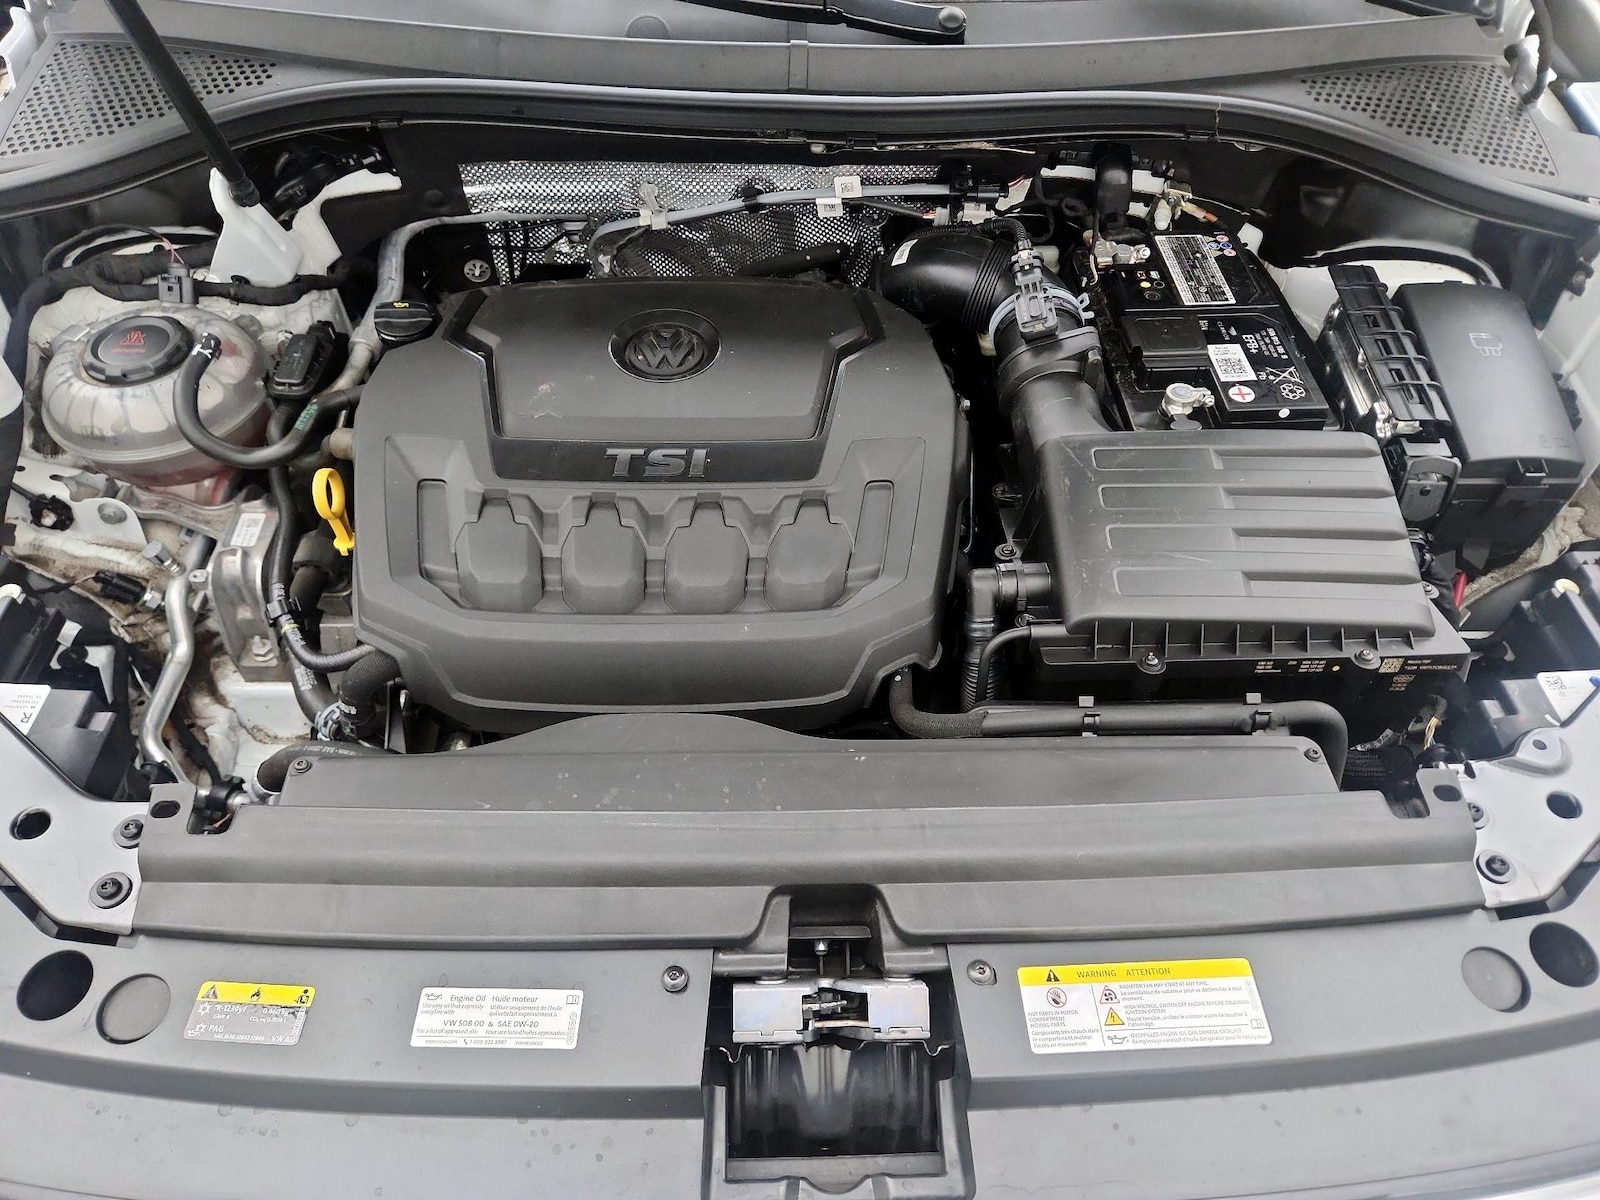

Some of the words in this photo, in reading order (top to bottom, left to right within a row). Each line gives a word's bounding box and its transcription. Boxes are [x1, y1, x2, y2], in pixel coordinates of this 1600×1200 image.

[1242, 334, 1259, 354] EFB+
[604, 448, 709, 478] TSI
[21, 712, 32, 723] R
[1126, 968, 1170, 976] ATTENTION
